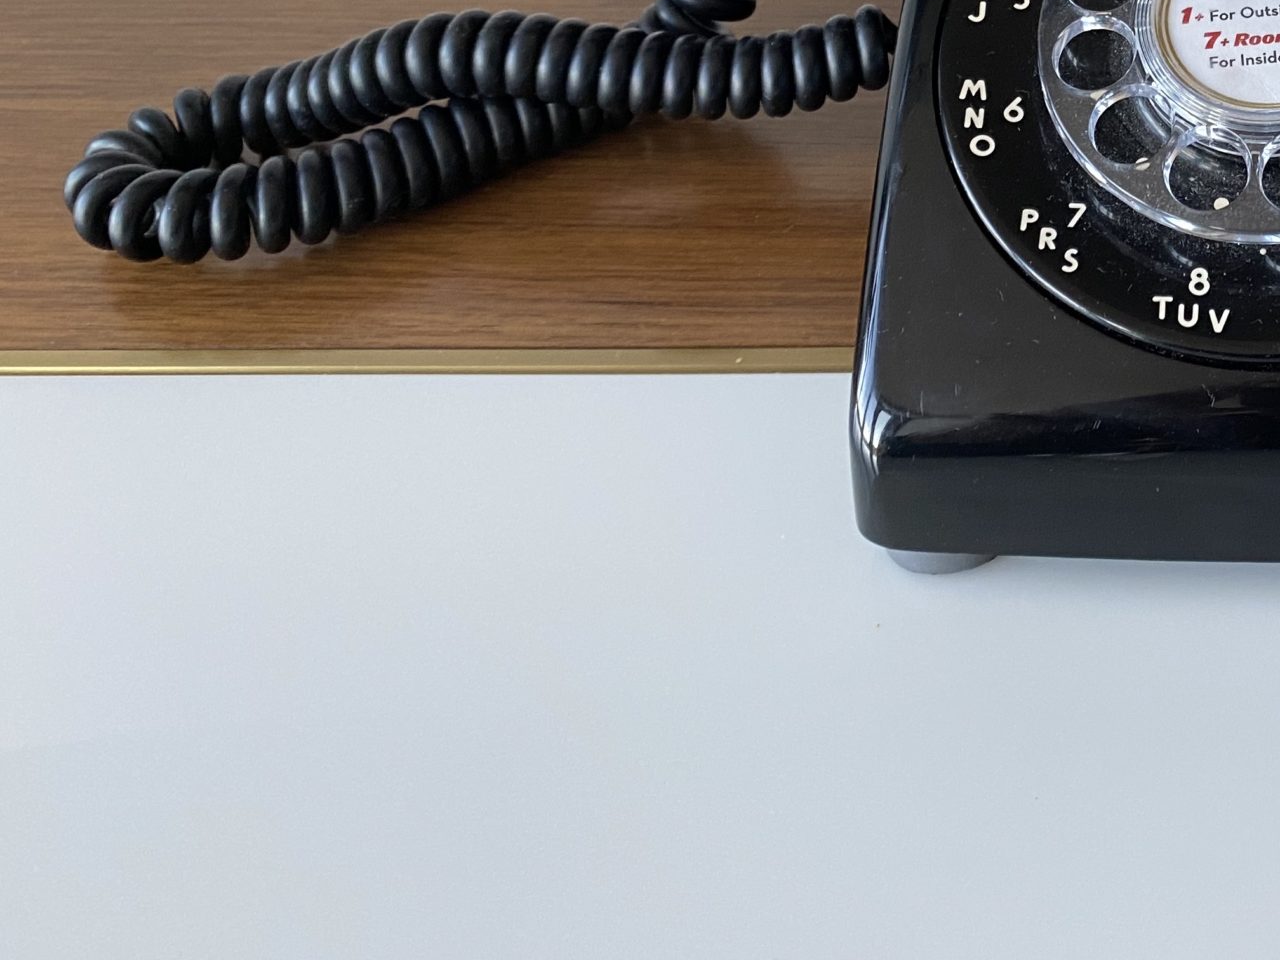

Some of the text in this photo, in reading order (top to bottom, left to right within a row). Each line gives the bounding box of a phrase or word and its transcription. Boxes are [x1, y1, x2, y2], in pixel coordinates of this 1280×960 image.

[1209, 9, 1236, 23] For
[1203, 30, 1230, 50] 7+
[1209, 55, 1236, 69] For
[1002, 95, 1026, 124] 6
[1066, 201, 1088, 229] 7
[1018, 207, 1081, 274] PRS
[1187, 266, 1212, 297] 8
[1150, 294, 1232, 334] TUV
